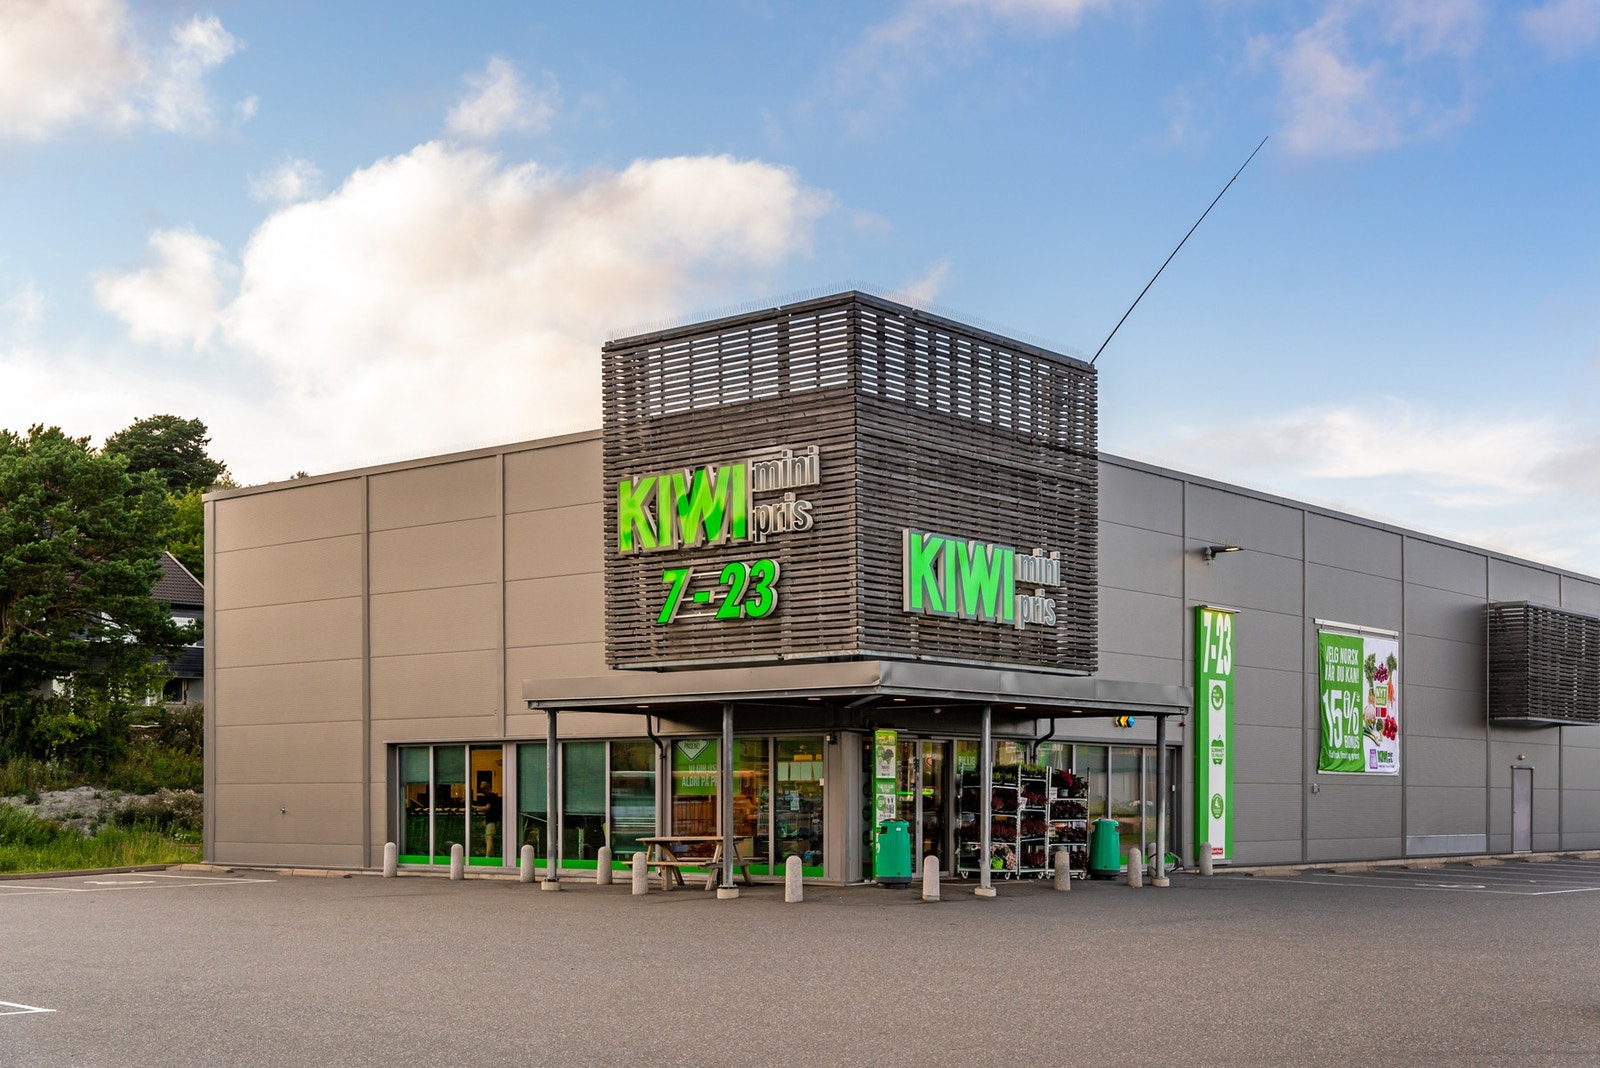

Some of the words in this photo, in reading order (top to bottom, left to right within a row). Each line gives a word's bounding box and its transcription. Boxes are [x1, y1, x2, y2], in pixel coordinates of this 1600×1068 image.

[618, 460, 752, 554] KIWI
[754, 445, 822, 492] mini
[754, 492, 815, 543] pris
[903, 528, 1016, 625] KIWI
[1015, 548, 1061, 586] mini
[1015, 588, 1057, 630] pris
[1203, 612, 1232, 676] 7-23
[1322, 689, 1360, 748] 15%
